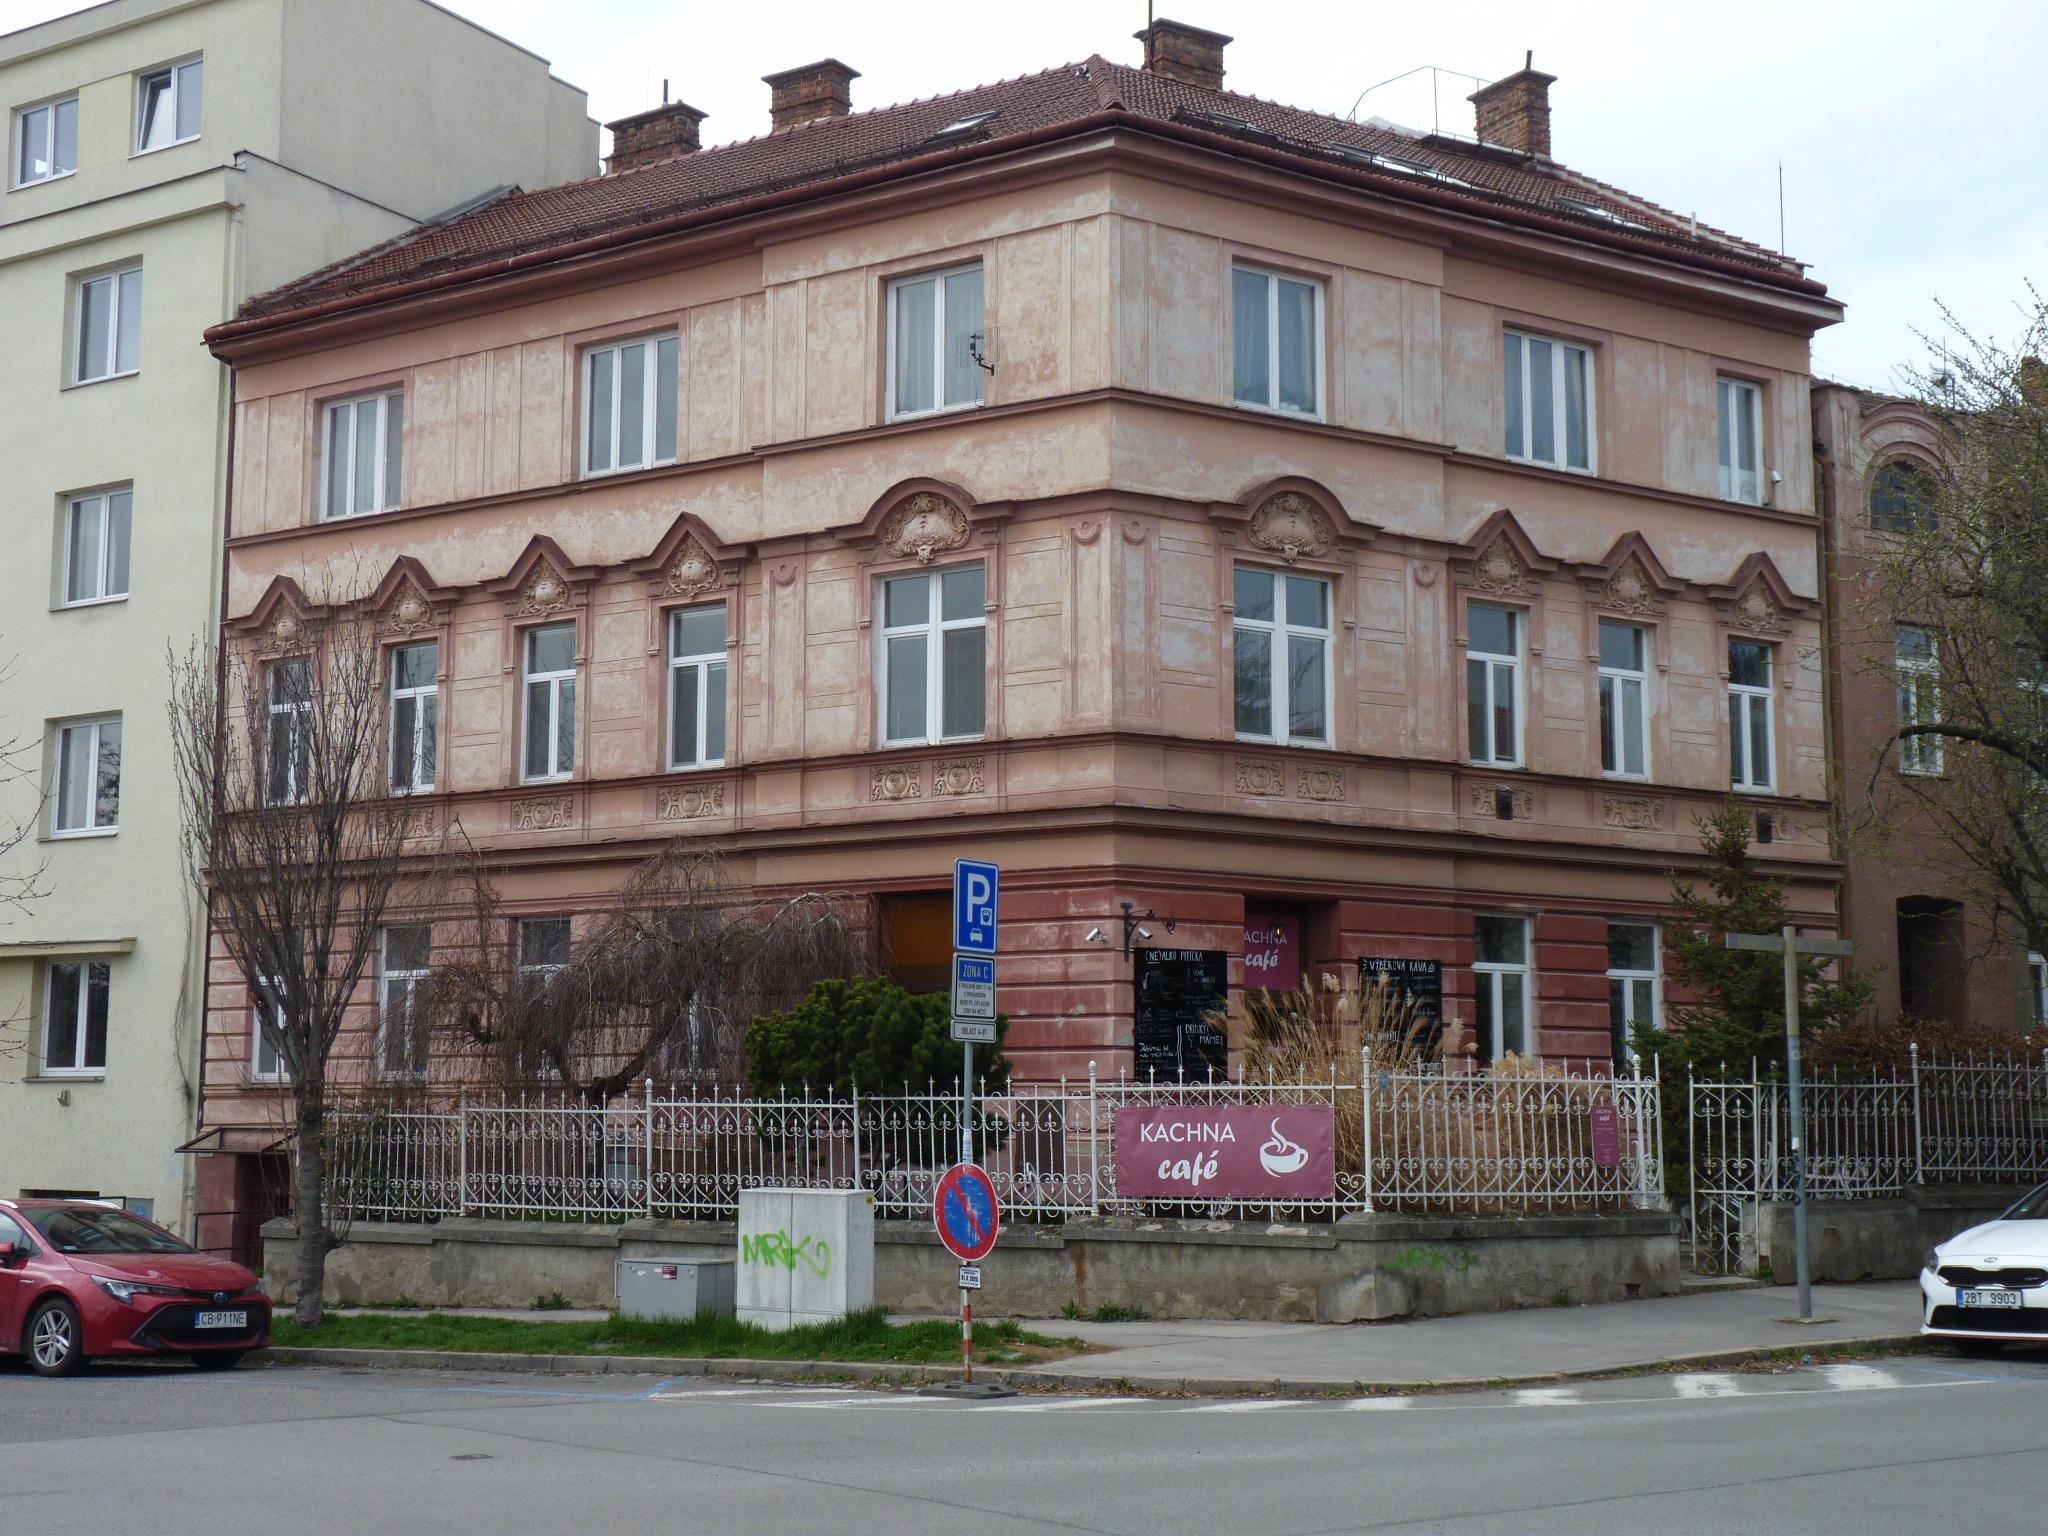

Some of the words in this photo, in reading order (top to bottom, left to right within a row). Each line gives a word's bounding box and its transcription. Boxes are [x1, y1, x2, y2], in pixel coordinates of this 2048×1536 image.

[967, 873, 990, 923] P
[1245, 949, 1279, 971] café
[1140, 1122, 1236, 1143] KACHNA
[1158, 1150, 1219, 1186] café
[1965, 1292, 1983, 1304] 2BT
[1990, 1292, 2017, 1305] 9903
[202, 1314, 213, 1324] CB
[217, 1313, 244, 1324] 911NE
